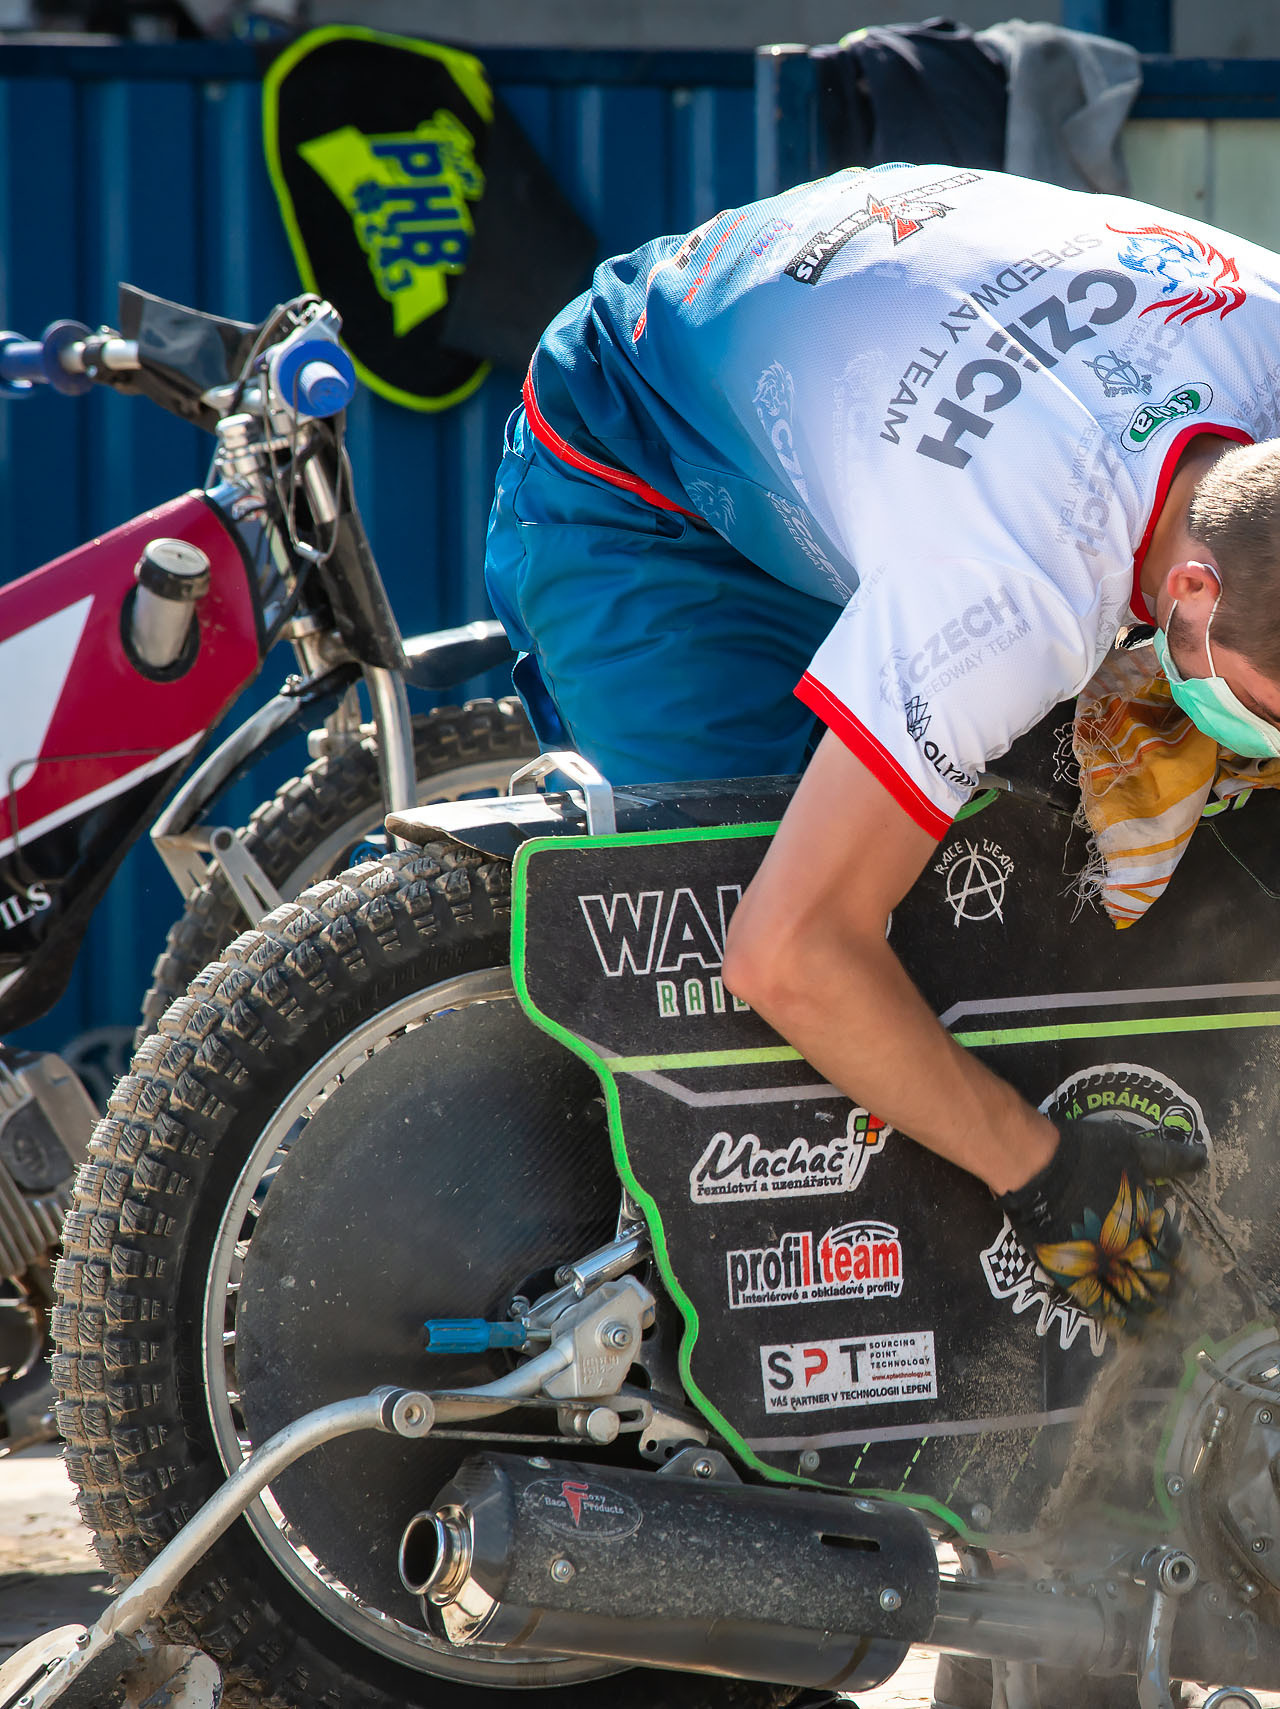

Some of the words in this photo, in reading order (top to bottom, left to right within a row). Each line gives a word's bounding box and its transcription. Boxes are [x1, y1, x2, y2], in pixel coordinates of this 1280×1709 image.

[939, 232, 1102, 343] SPEEDWAY
[916, 269, 1137, 469] CZECH
[880, 347, 949, 446] TEAM
[908, 585, 1021, 684] CZECH
[934, 841, 964, 876] RACE
[1087, 1087, 1161, 1122] DRÁHA
[696, 1139, 848, 1182] Machač
[761, 1183, 768, 1192] a
[801, 1291, 809, 1299] a
[869, 1339, 916, 1349] SOURCING
[870, 1350, 897, 1359] POINT
[871, 1357, 930, 1369] TECHNOLOGY
[831, 1392, 838, 1401] V
